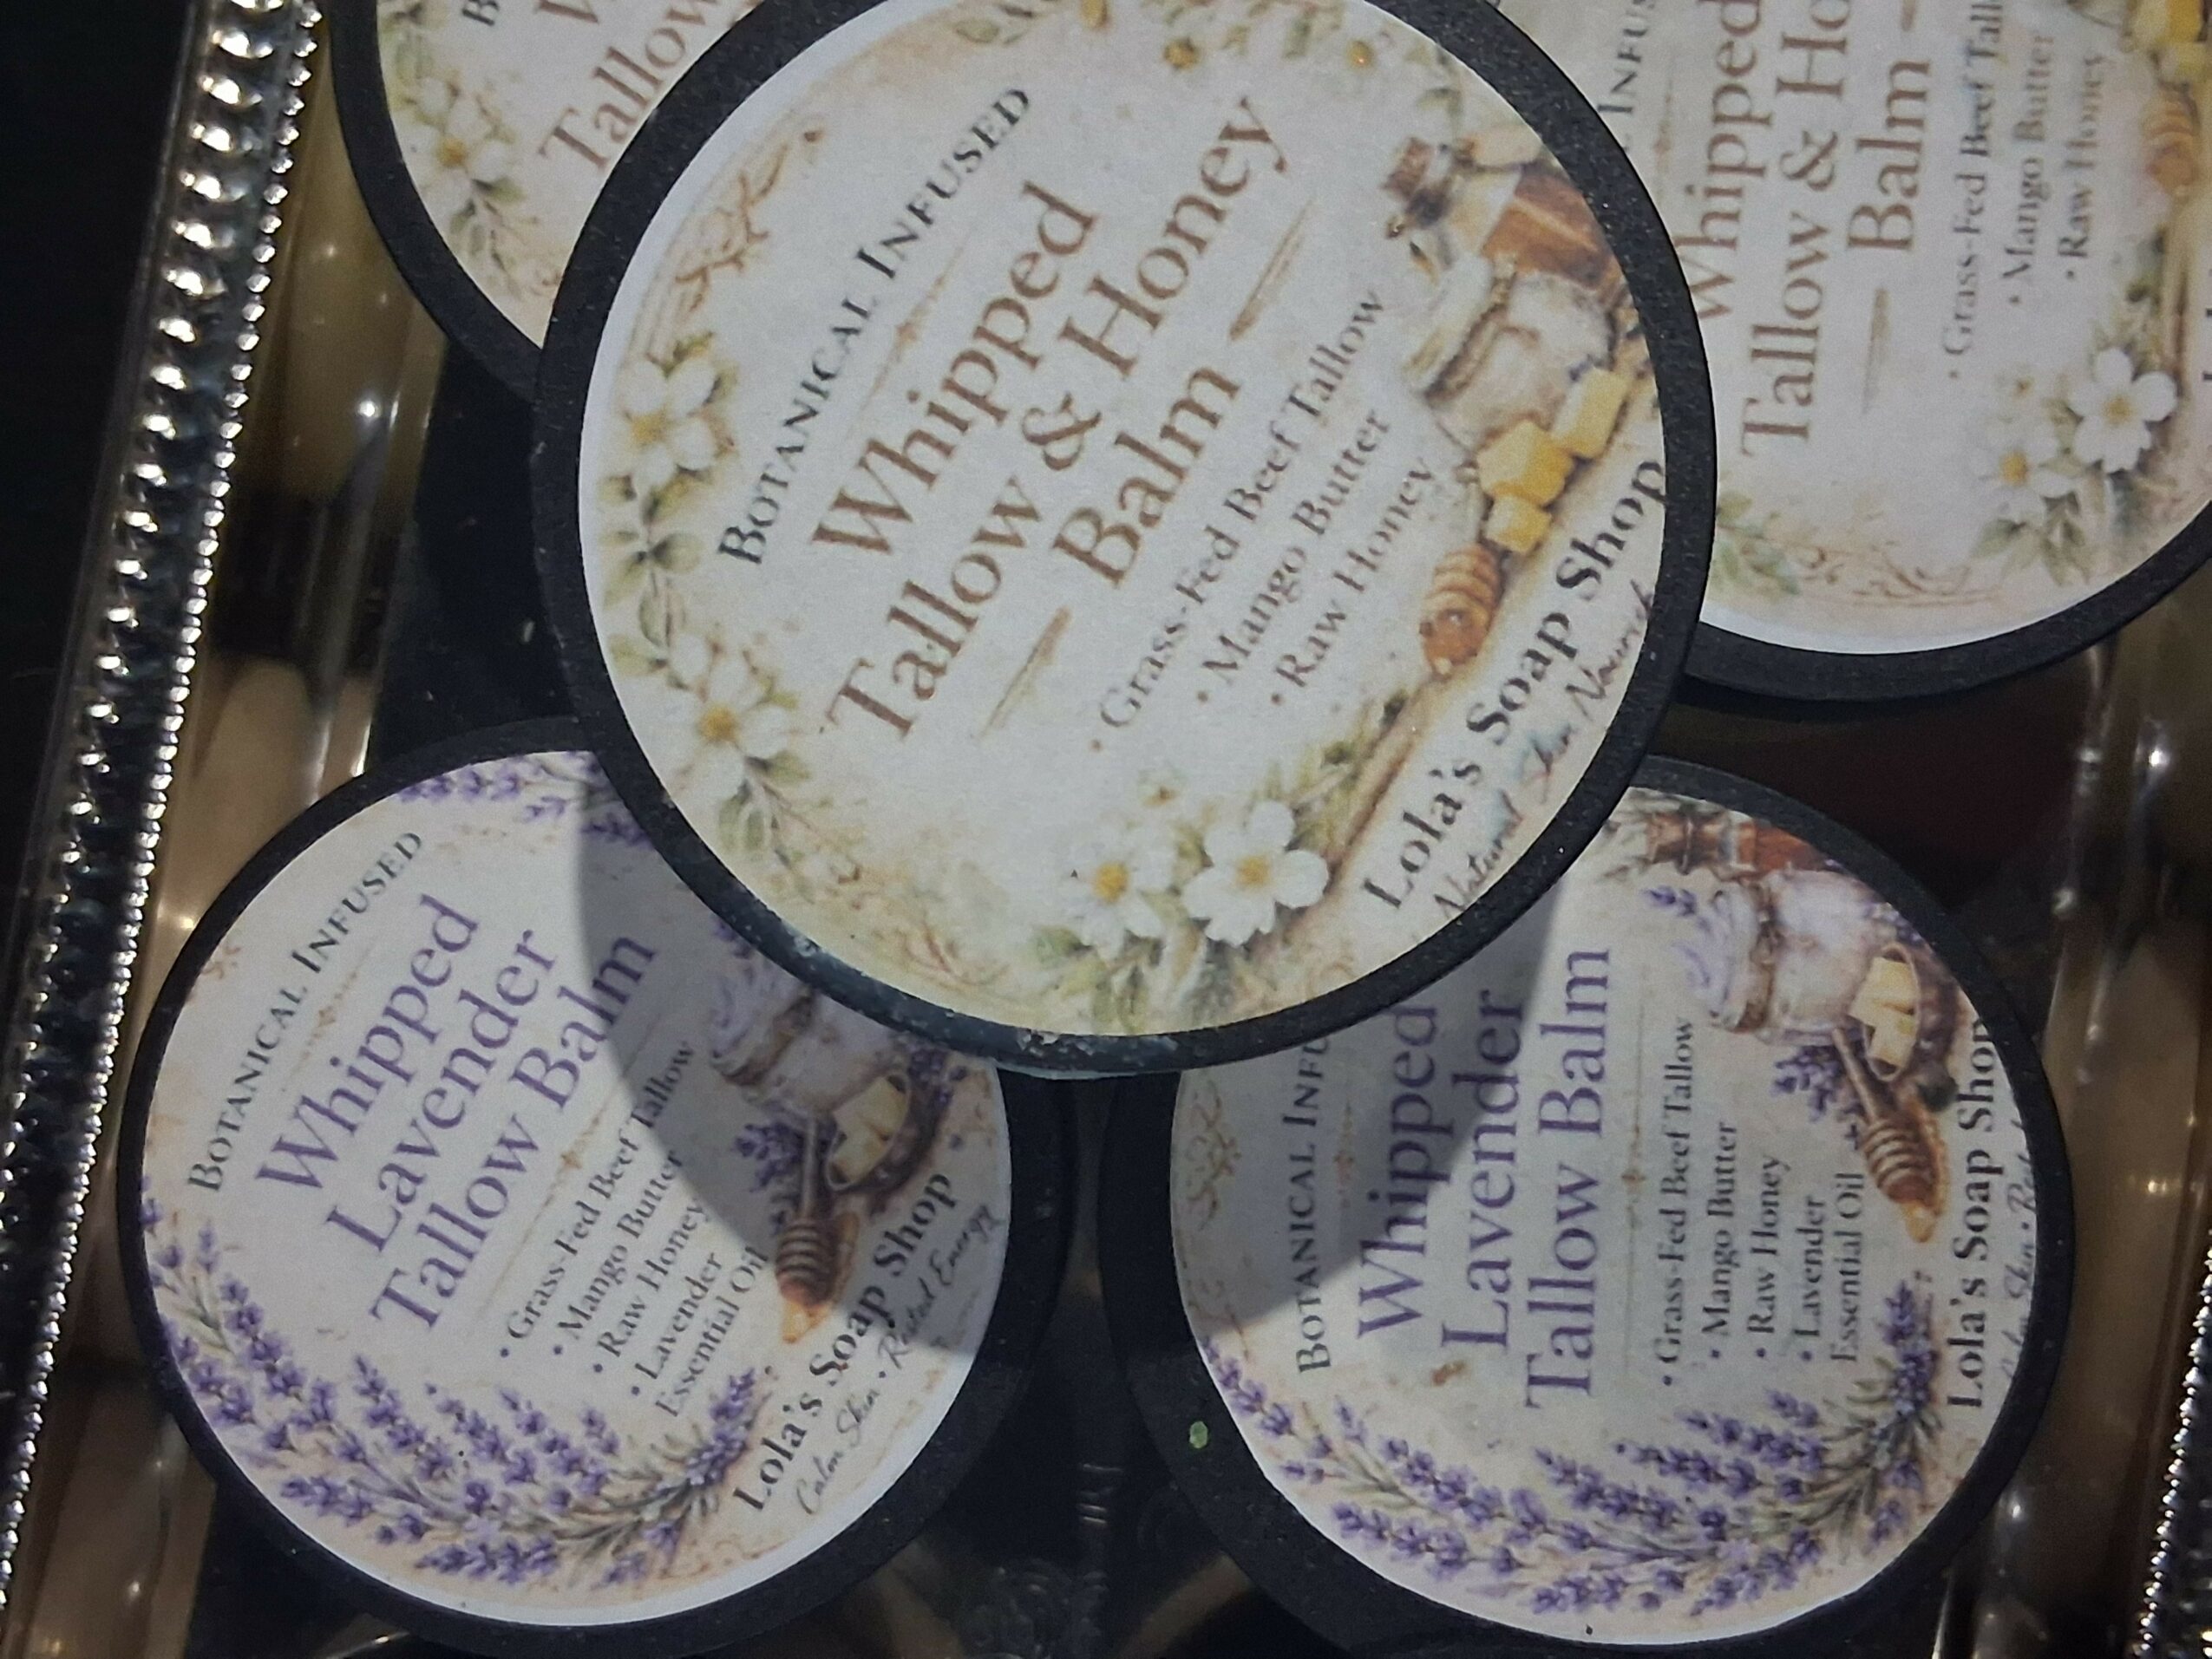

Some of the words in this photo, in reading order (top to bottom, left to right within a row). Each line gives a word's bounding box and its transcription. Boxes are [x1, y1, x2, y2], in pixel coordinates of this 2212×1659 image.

[1672, 0, 1772, 320] Whipped
[1780, 131, 1839, 192] &
[1847, 58, 1930, 251] Balm
[1960, 81, 1995, 159] Beef
[2012, 33, 2054, 144] Butter
[2060, 52, 2105, 171] Honey
[1057, 95, 1286, 379] Honey
[1943, 173, 1987, 356] Grass-Fed
[2002, 158, 2052, 281] Mango
[2057, 184, 2092, 259] Raw
[717, 296, 878, 564] BOTANICAL
[857, 88, 1030, 279] INFUSED
[811, 179, 1099, 555] Whipped
[1742, 211, 1829, 457] Tallow
[1021, 392, 1102, 471] &
[1053, 366, 1240, 588] Balm
[1098, 524, 1241, 728] Grass-Fed
[1224, 420, 1301, 521] Beef
[1285, 291, 1384, 420] Tallow
[825, 475, 1042, 740] Tallow
[1202, 546, 1307, 684] Mango
[1293, 409, 1391, 537] Butter
[1277, 599, 1347, 689] Raw
[1332, 456, 1437, 593] Honey
[1363, 761, 1482, 911] Lola's
[1467, 611, 1578, 745] Soap
[1556, 460, 1666, 599] Shop
[188, 986, 308, 1192] BOTANICAL
[291, 833, 423, 973] INFUSED
[255, 894, 480, 1189] Whipped
[327, 929, 556, 1253] Lavender
[1538, 950, 1609, 1135] Balm
[1663, 1016, 1693, 1121] Tallow
[370, 1115, 540, 1329] Tallow
[510, 937, 656, 1109] Balm
[507, 1199, 601, 1342] Grass-Fed
[588, 1127, 639, 1200] Beef
[626, 1042, 693, 1128] Tallow
[1358, 1005, 1454, 1339] Whipped
[1442, 990, 1523, 1349] Lavender
[1659, 1125, 1691, 1197] Beef
[1708, 1123, 1737, 1217] Butter
[1753, 1155, 1790, 1256] Honey
[1836, 1174, 1864, 1218] Oil
[1953, 1148, 2003, 1261] Soap
[557, 1244, 629, 1341] Mango
[617, 1149, 684, 1239] Butter
[597, 1295, 646, 1358] Raw
[636, 1199, 710, 1292] Honey
[634, 1251, 723, 1380] Lavender
[655, 1296, 740, 1418] Essential
[730, 1245, 769, 1294] Oil
[1289, 1143, 1331, 1373] BOTANICAL
[1525, 1164, 1600, 1408] Tallow
[1658, 1206, 1687, 1363] Grass-Fed
[1702, 1230, 1740, 1336] Mango
[1749, 1273, 1776, 1335] Raw
[1795, 1196, 1824, 1338] Lavender
[1831, 1231, 1862, 1362] Essential
[733, 1393, 821, 1511] Lola's
[809, 1285, 896, 1387] Soap
[874, 1172, 959, 1276] Shop
[796, 1449, 842, 1515] Calm
[837, 1388, 880, 1447] Skin
[878, 1283, 935, 1369] Rested
[1947, 1278, 1986, 1408] Lola's
